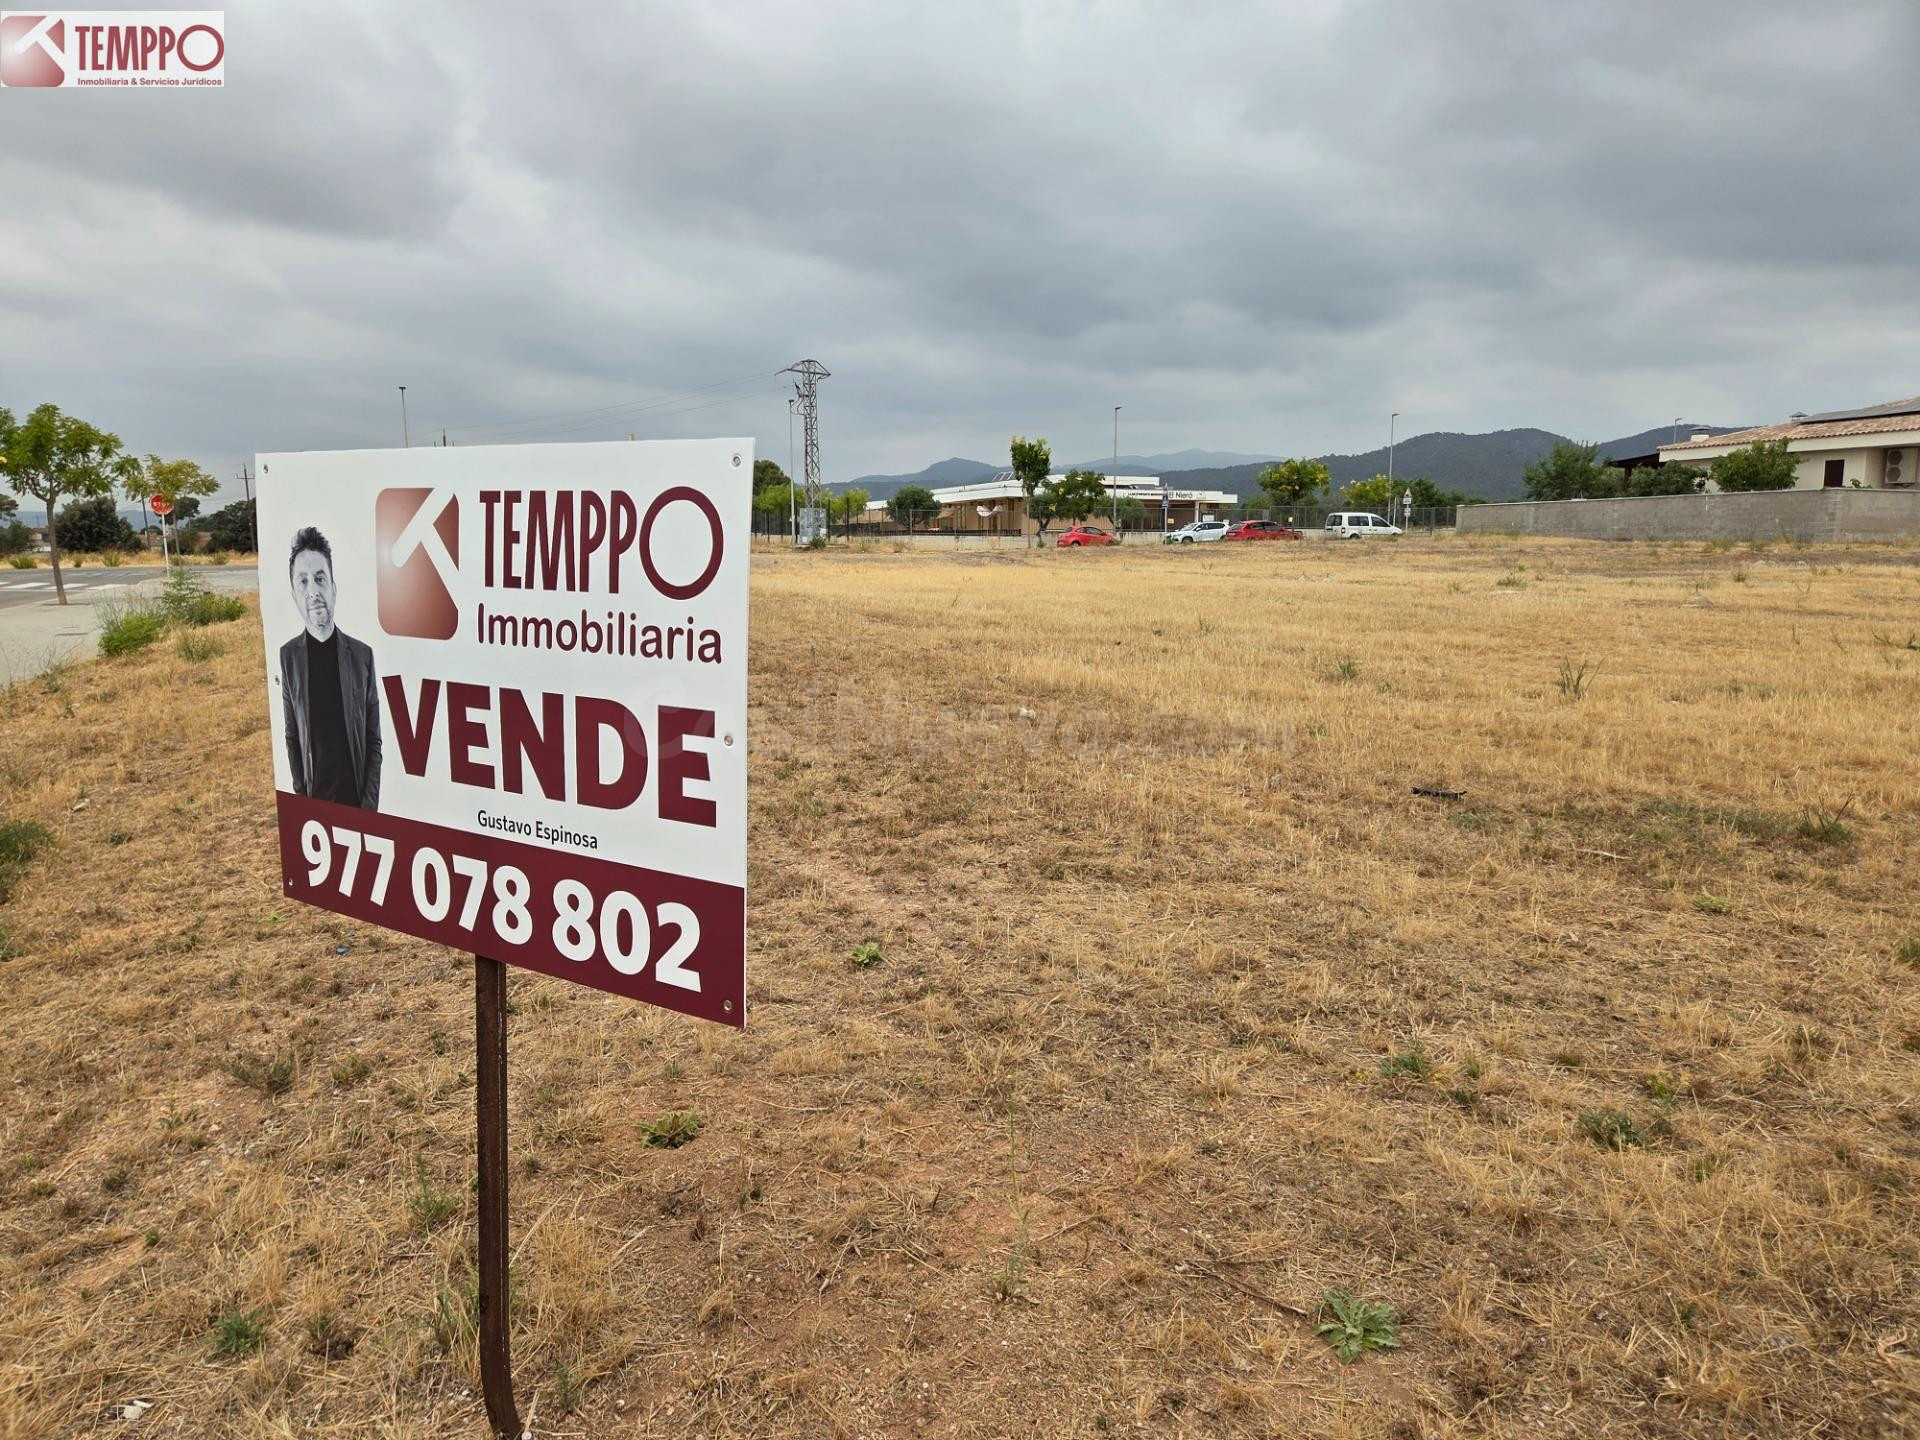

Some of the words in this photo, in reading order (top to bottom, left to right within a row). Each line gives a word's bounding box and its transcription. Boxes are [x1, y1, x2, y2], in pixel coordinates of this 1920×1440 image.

[480, 486, 724, 600] TEMPPO
[478, 603, 722, 664] Immobiliaria
[382, 675, 717, 828] VENDE
[477, 809, 531, 836] Gustavo
[535, 821, 598, 849] Espinosa
[301, 820, 395, 907] 977
[411, 847, 533, 945] 078
[552, 878, 702, 993] 802
